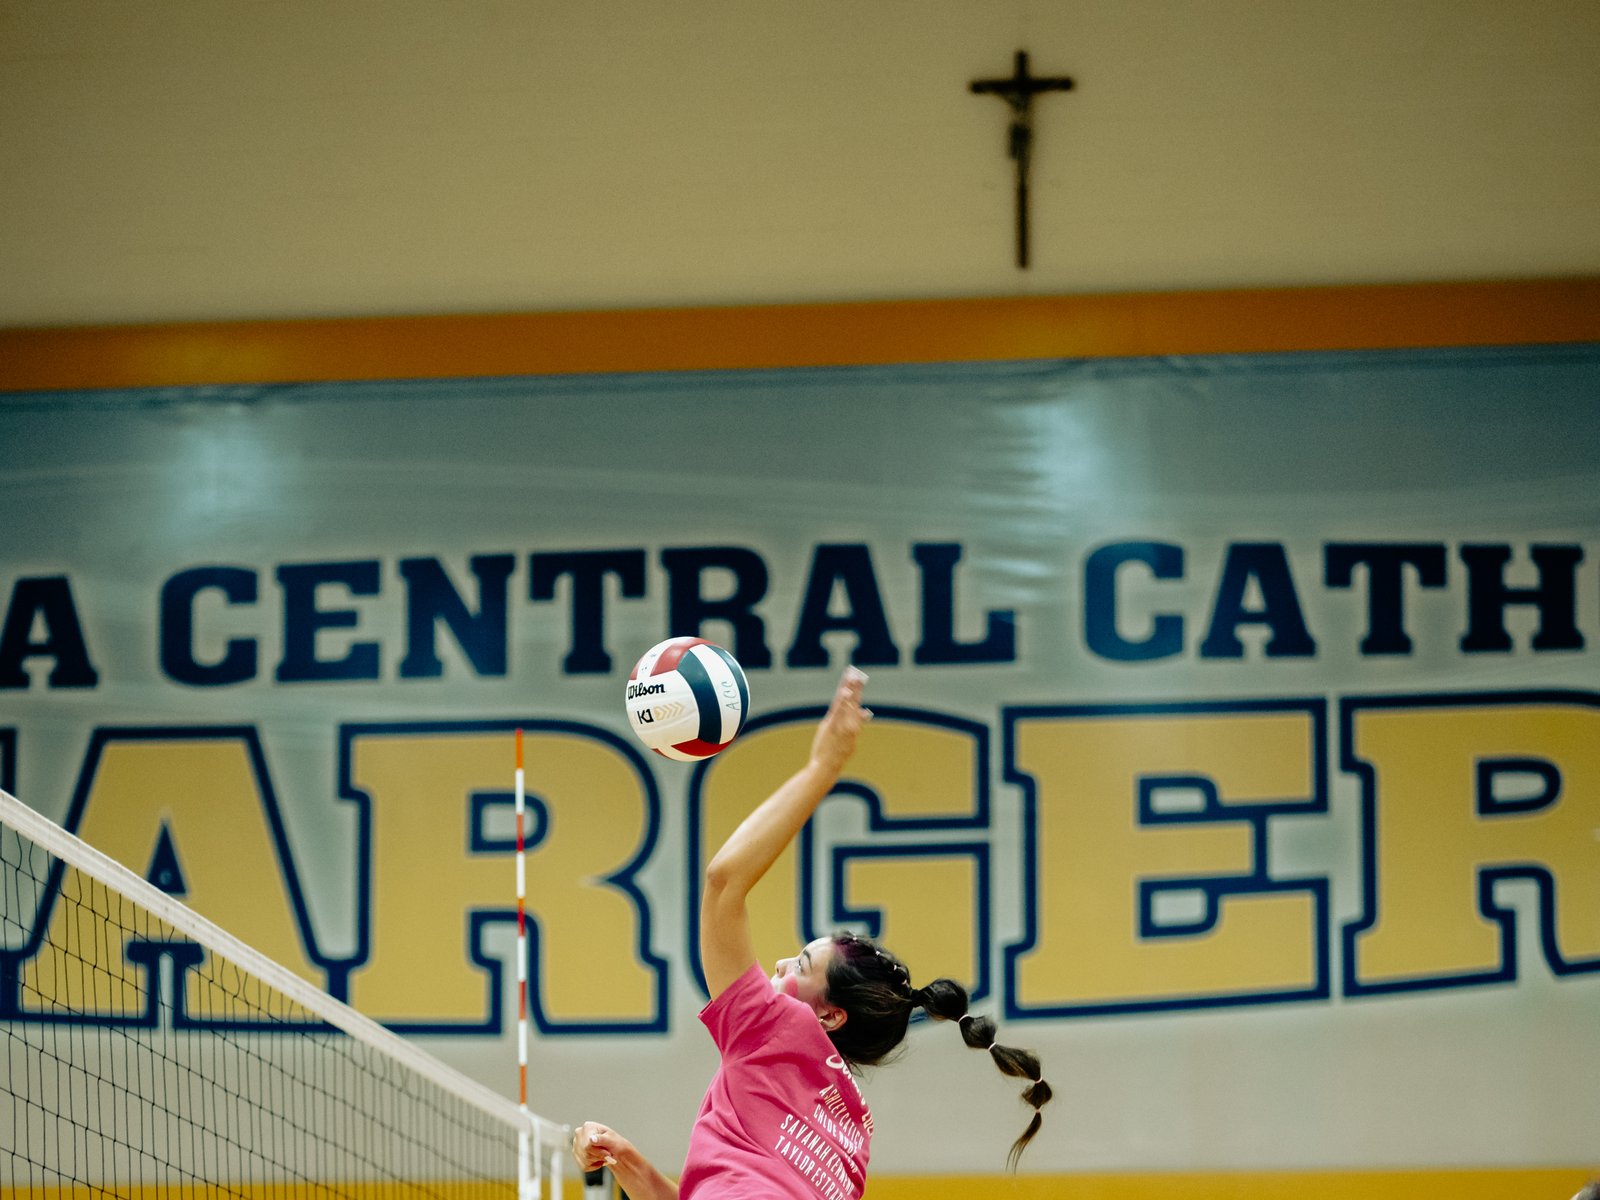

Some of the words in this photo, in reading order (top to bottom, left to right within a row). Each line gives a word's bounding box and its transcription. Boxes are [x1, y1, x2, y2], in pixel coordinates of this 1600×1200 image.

[159, 542, 1017, 687] CENTRAL
[1082, 541, 1585, 661] CATH
[627, 682, 666, 700] Wilson
[0, 690, 1600, 1035] ARGER
[813, 1104, 837, 1137] CHLOE
[818, 1084, 847, 1117] ASHLEY
[775, 1135, 815, 1176] TAYLOR
[780, 1114, 831, 1161] SAVANAH
